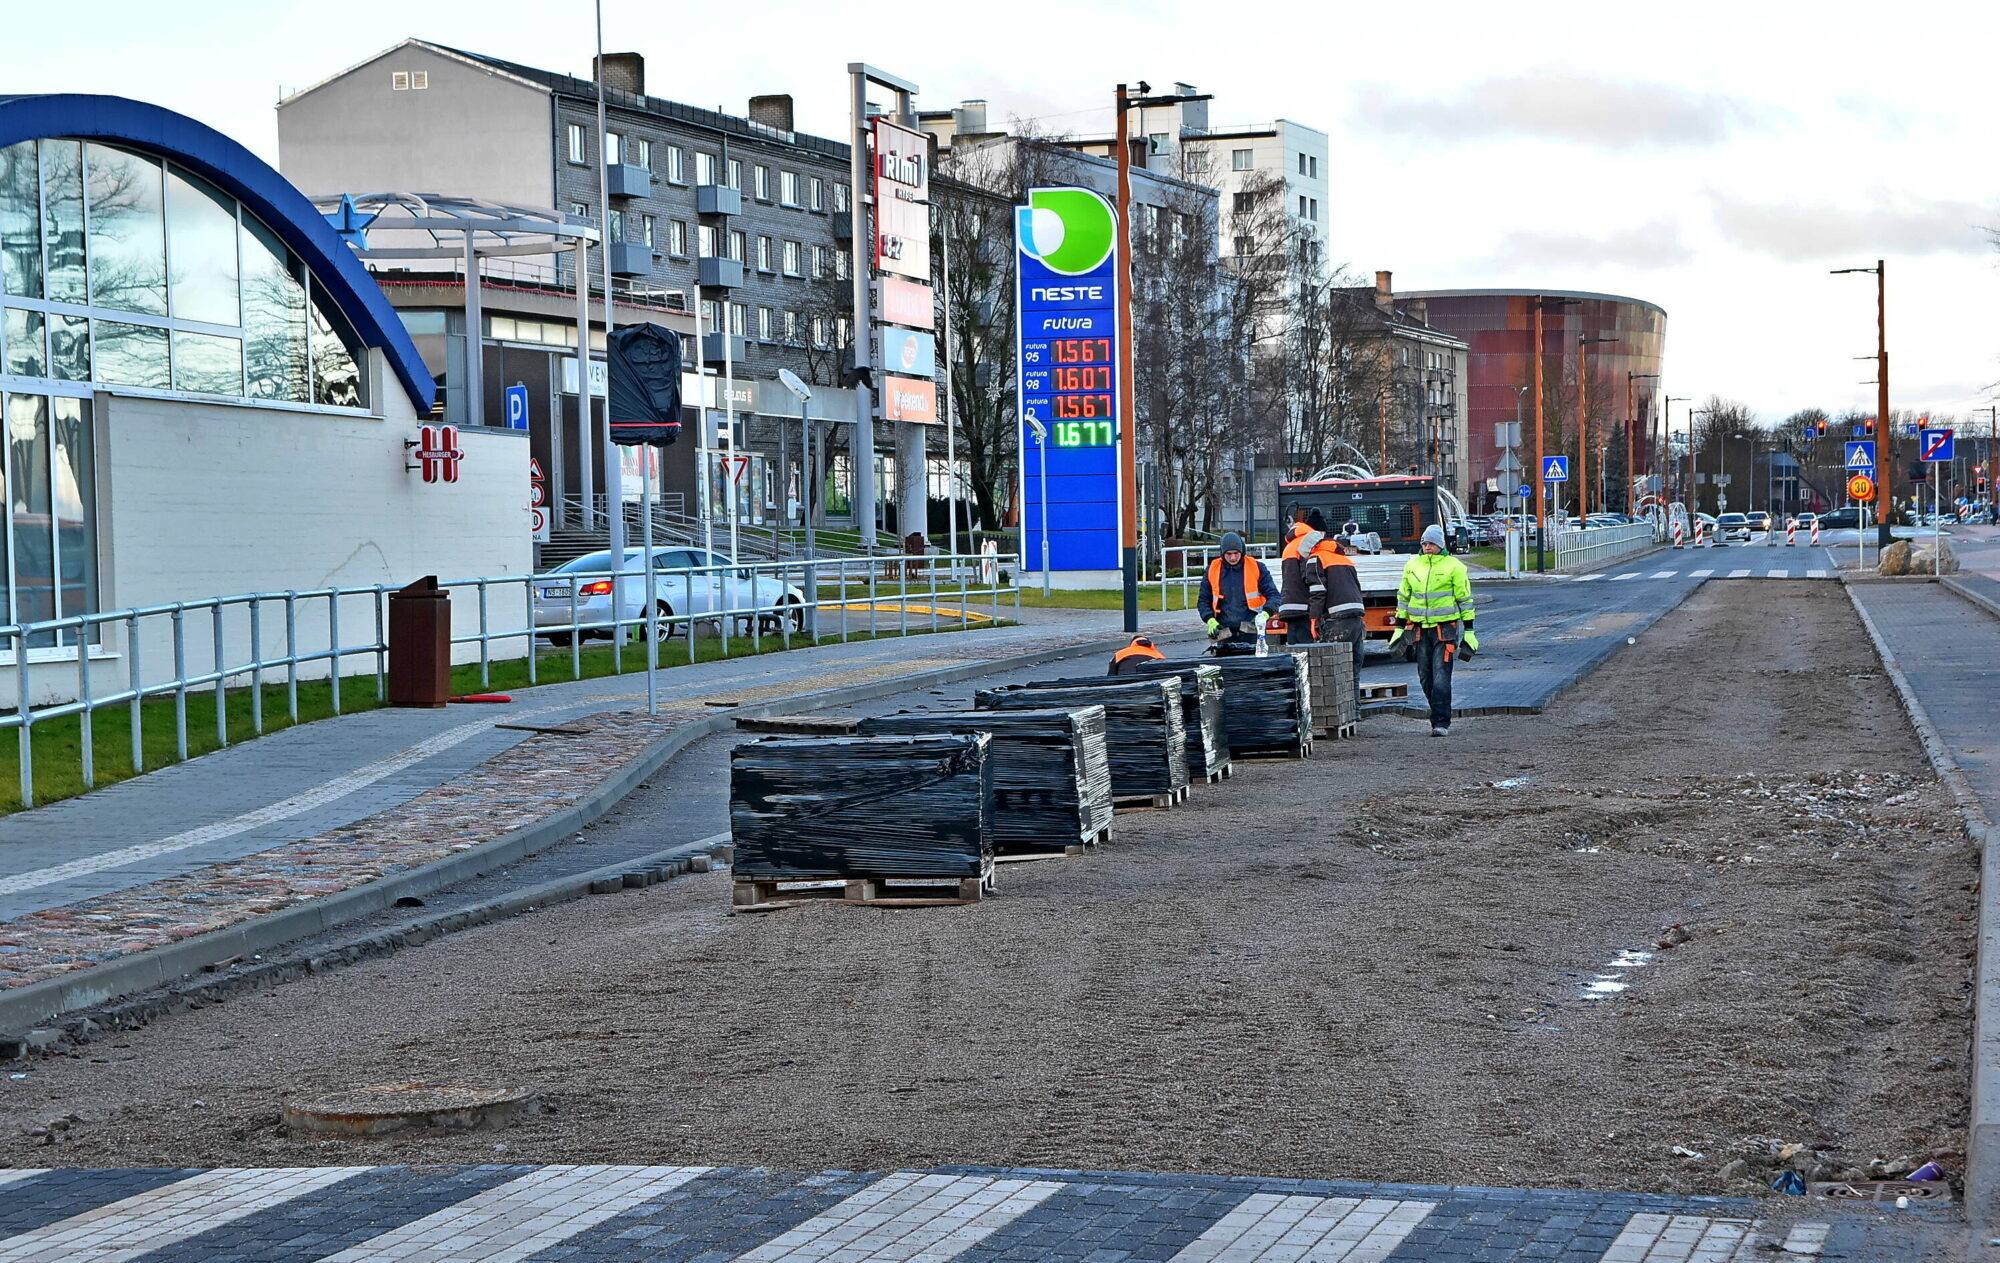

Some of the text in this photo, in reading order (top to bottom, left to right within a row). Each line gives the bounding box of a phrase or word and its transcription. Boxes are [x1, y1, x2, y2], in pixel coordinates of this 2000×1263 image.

[1032, 286, 1102, 301] NESTE
[1043, 317, 1092, 330] Futura
[1025, 352, 1039, 362] 95
[1056, 339, 1110, 363] 1.567
[1025, 379, 1040, 390] 98
[1056, 366, 1110, 391] 1.607
[510, 393, 522, 430] P
[1056, 394, 1111, 418] 1.567
[1056, 421, 1112, 446] 1.677
[1854, 481, 1867, 494] 30
